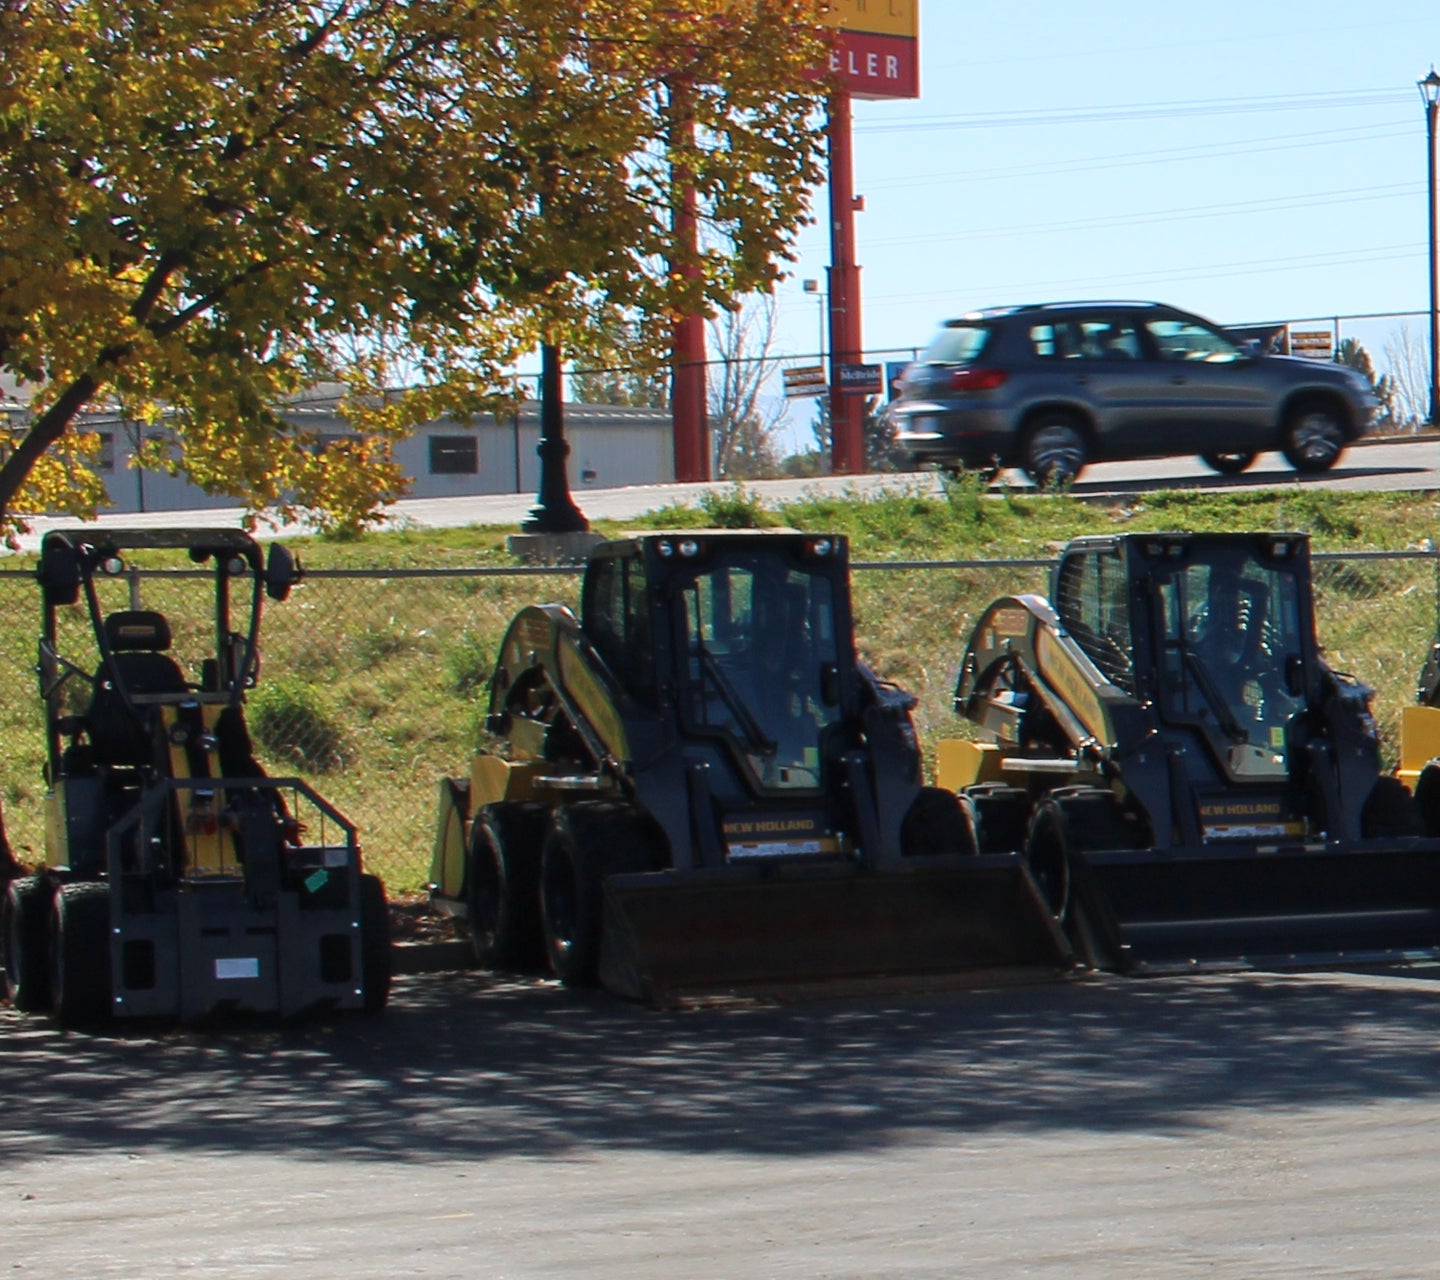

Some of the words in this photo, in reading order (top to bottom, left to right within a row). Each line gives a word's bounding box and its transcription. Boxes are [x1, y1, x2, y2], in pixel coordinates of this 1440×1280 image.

[1227, 803, 1281, 815] HOLLAND
[723, 822, 753, 833] NEW
[755, 819, 815, 832] HOLLAND
